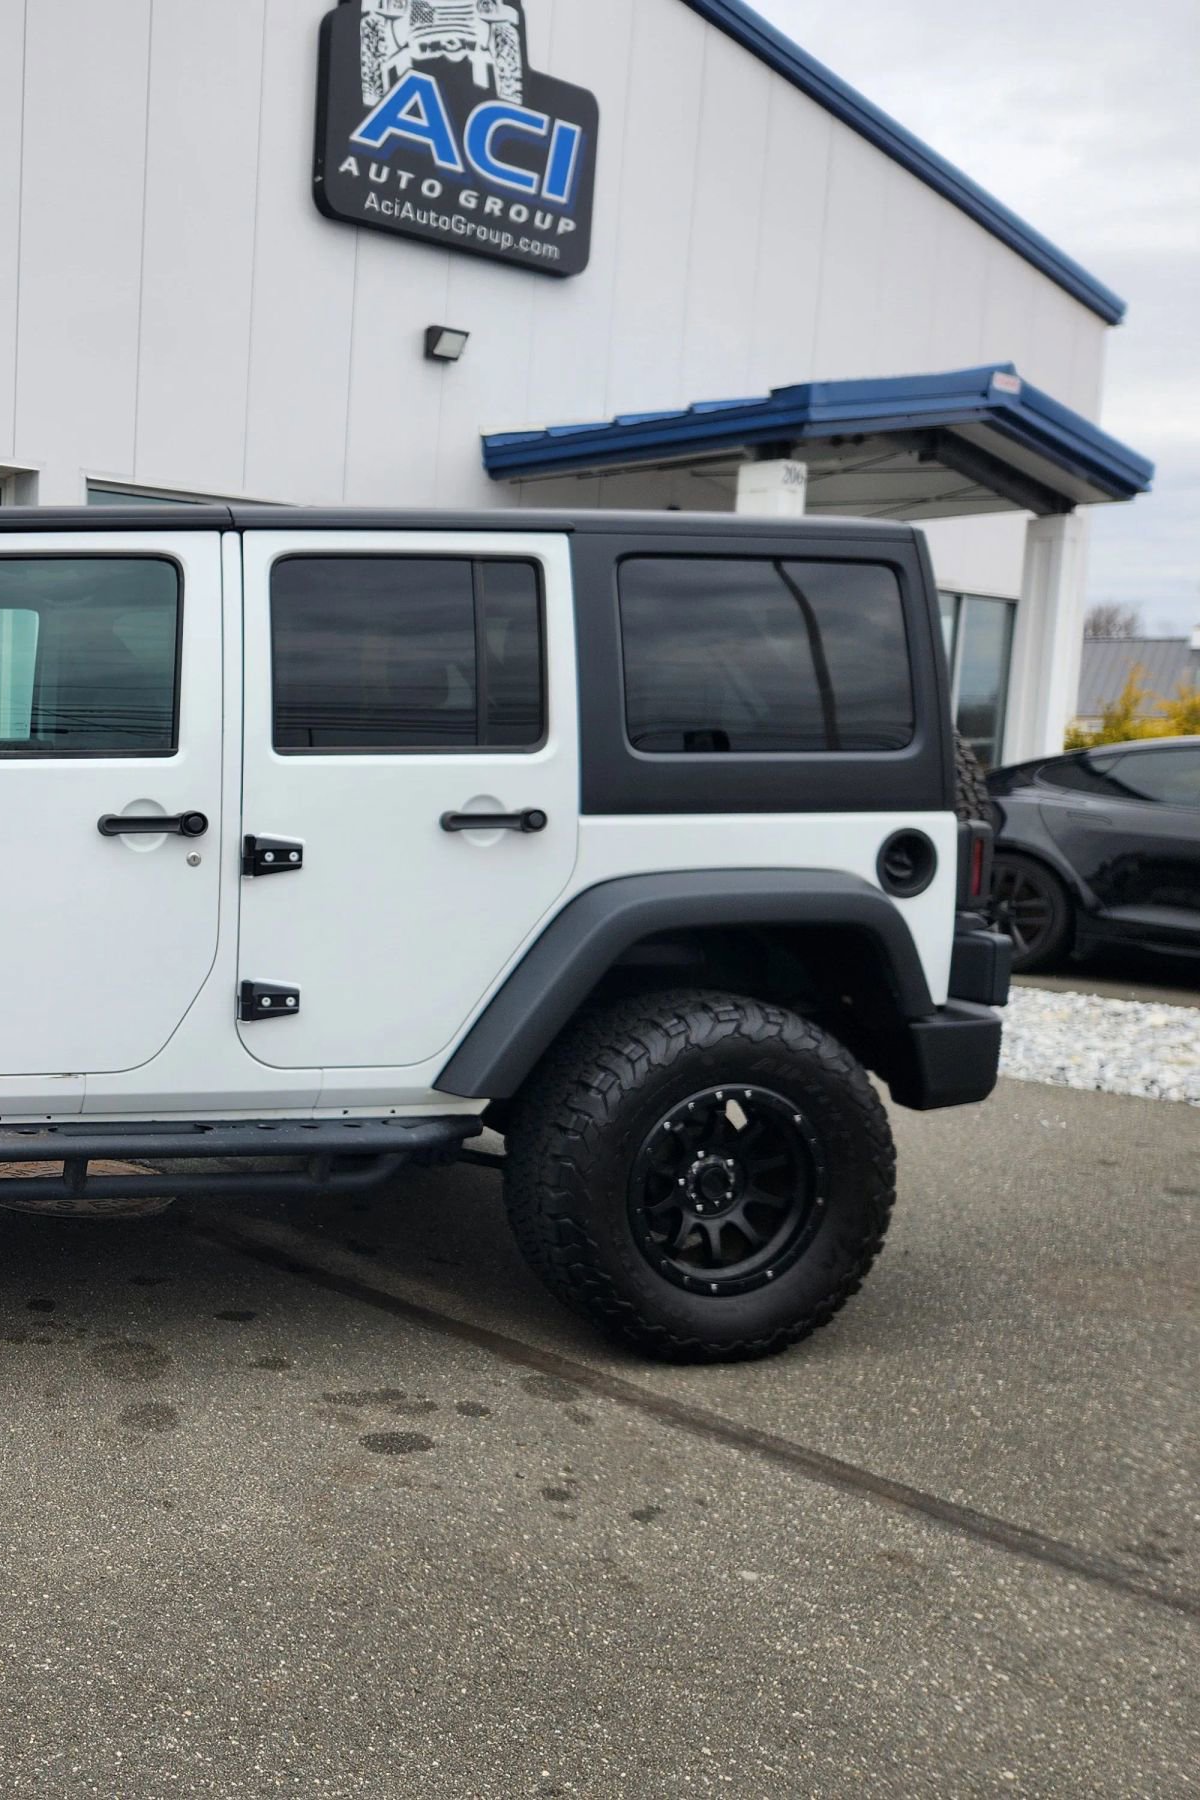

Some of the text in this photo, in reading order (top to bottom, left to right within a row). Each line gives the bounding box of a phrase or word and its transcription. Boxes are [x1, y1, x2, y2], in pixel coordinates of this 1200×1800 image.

[349, 69, 582, 203] ACI
[338, 156, 577, 235] AUTO GROUP
[364, 191, 561, 260] AciAutoGroup.com
